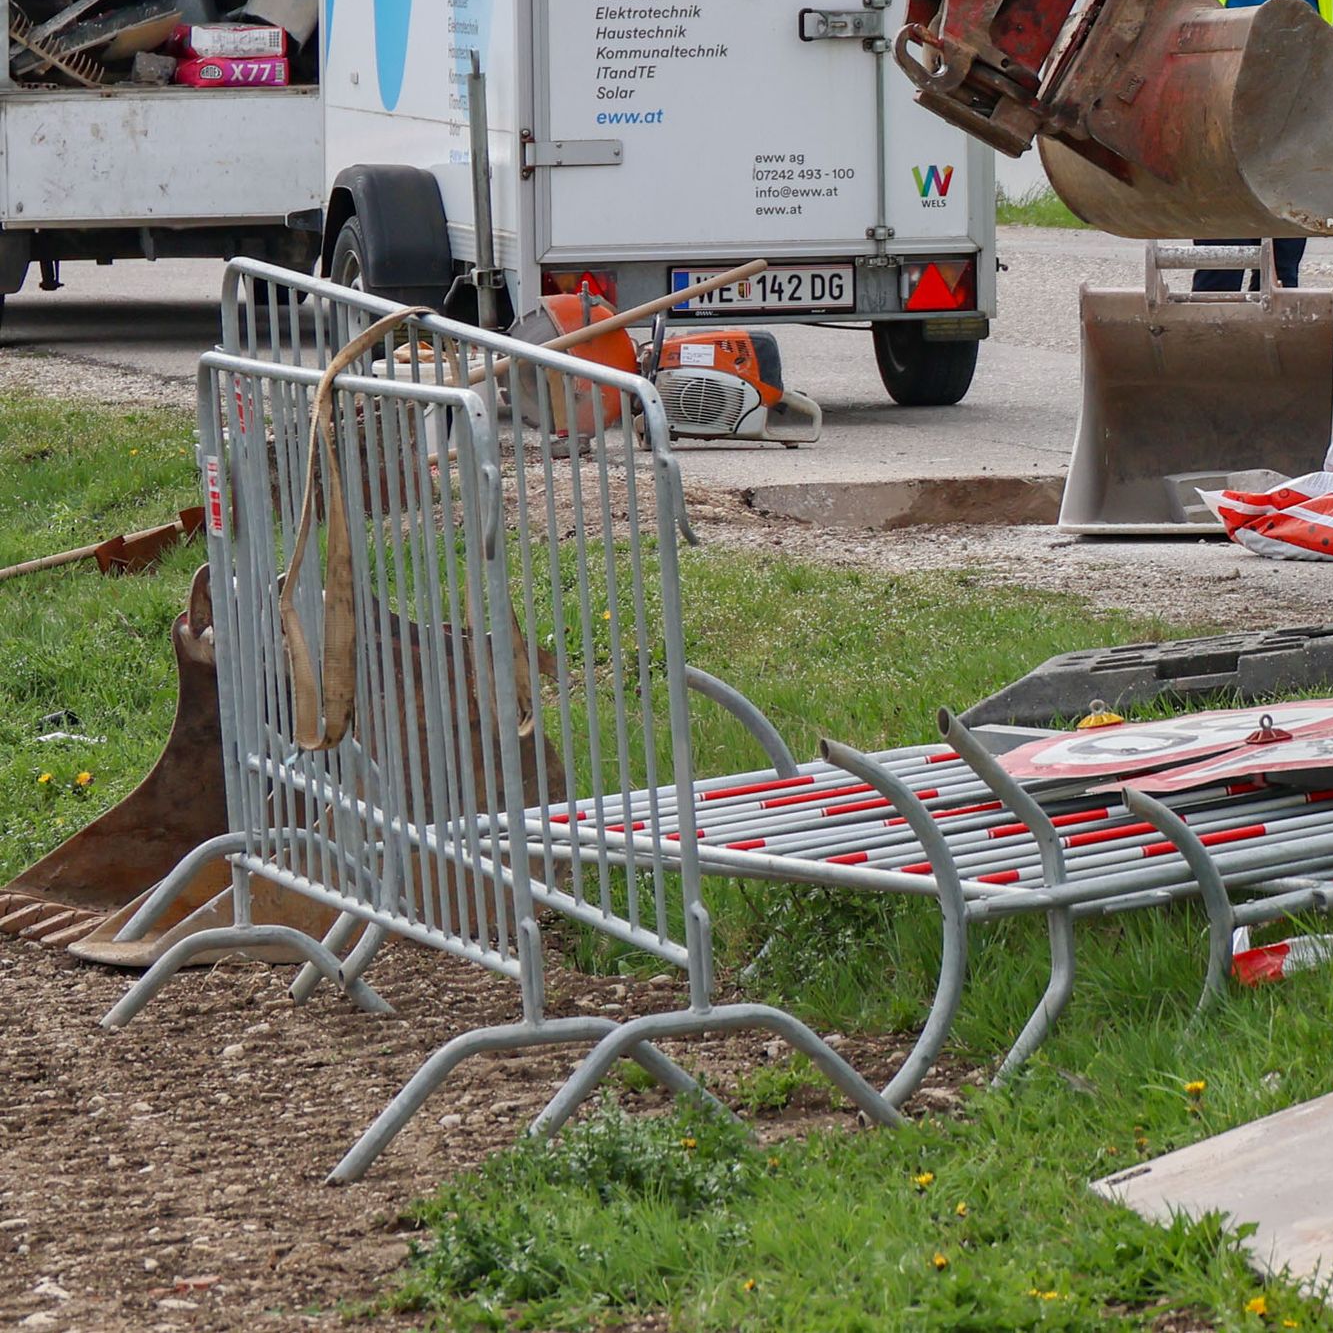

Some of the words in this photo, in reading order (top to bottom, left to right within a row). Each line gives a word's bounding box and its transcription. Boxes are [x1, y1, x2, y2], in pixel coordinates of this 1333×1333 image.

[595, 5, 702, 20] Elektrotechnik
[596, 25, 687, 40] Haustechnik
[596, 44, 728, 60] Kommunaltechnik
[596, 65, 657, 79] ITandTE
[596, 86, 635, 99] Solar
[596, 109, 663, 124] eww.at
[755, 154, 785, 164] eww
[789, 153, 805, 165] ag
[755, 169, 795, 181] 07242
[797, 168, 822, 180] 493
[832, 168, 855, 180] 100
[755, 186, 839, 198] info@eww.at
[755, 204, 803, 216] eww.at
[921, 199, 946, 208] WELS
[756, 273, 803, 303] 142
[810, 273, 844, 301] DG
